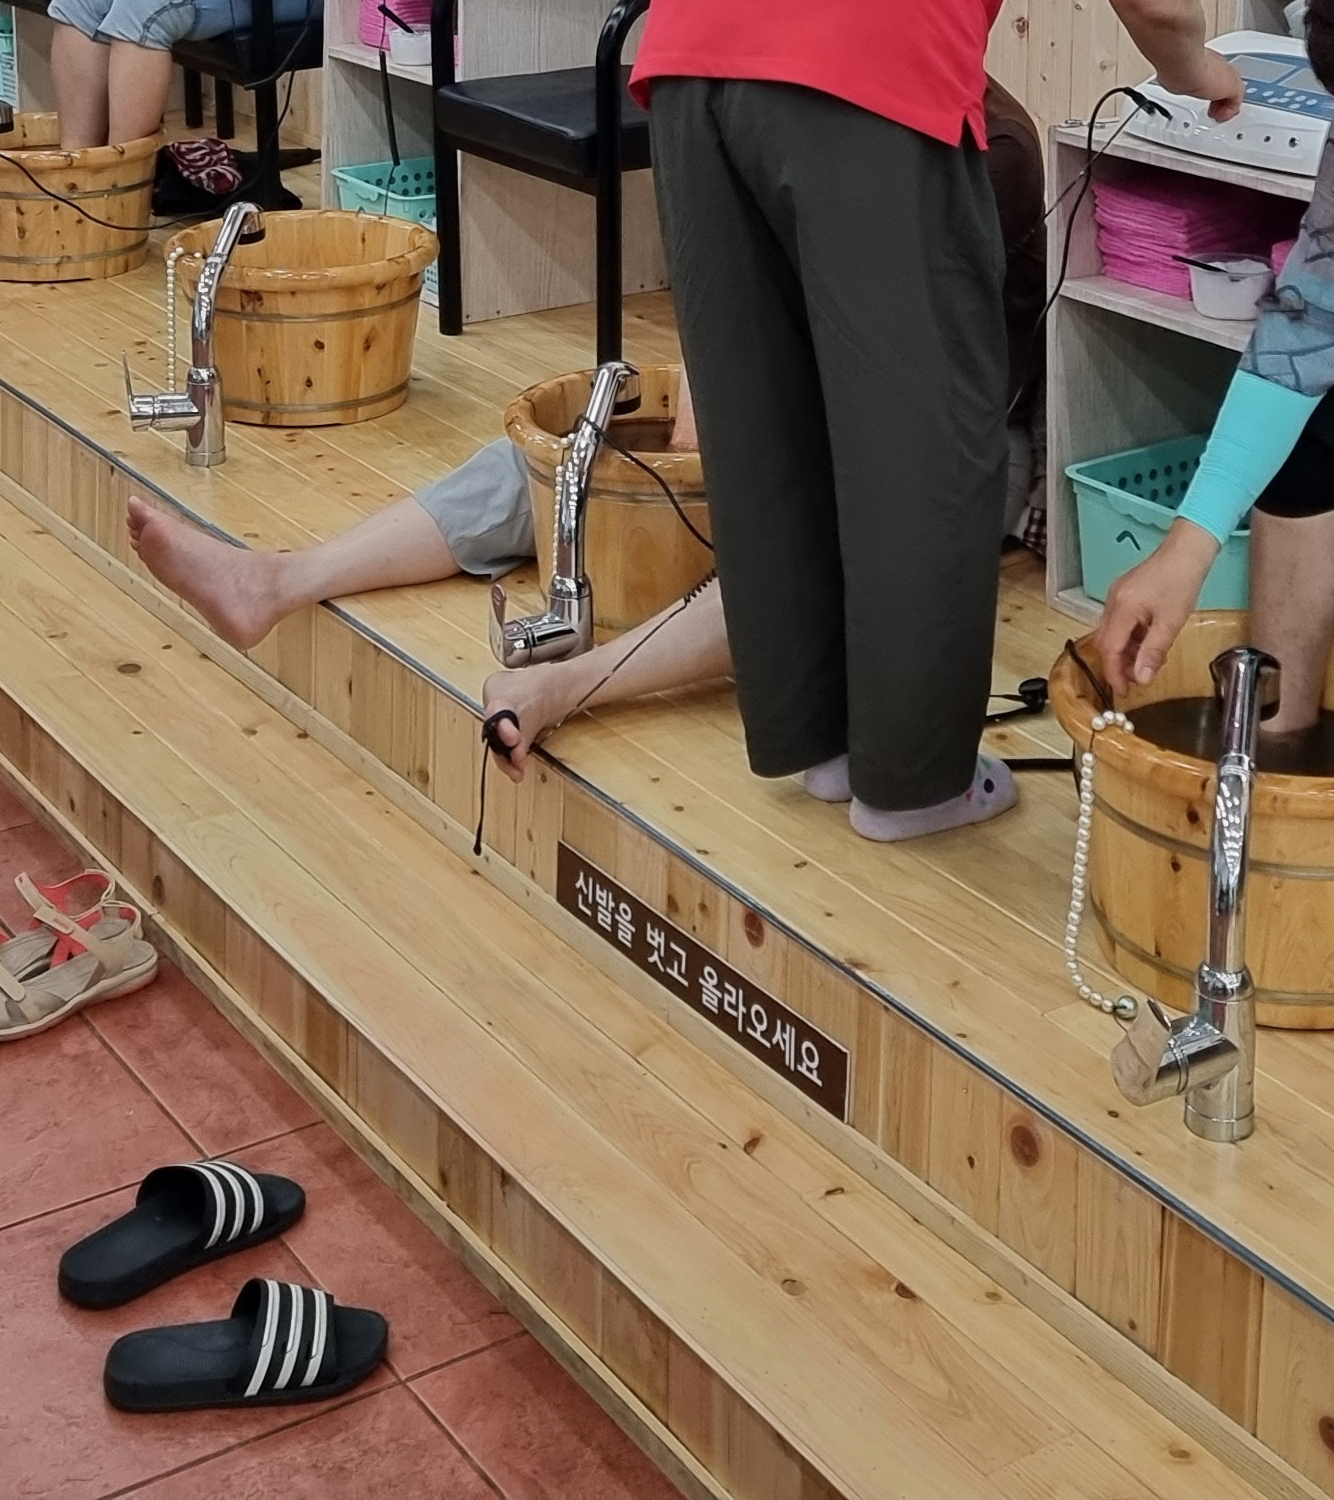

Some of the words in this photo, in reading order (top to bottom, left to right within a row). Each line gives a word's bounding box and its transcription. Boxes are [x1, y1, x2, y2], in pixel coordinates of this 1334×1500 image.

[574, 866, 637, 949] 신발을
[645, 919, 691, 988] 벗고
[697, 963, 824, 1088] 올라오세요
